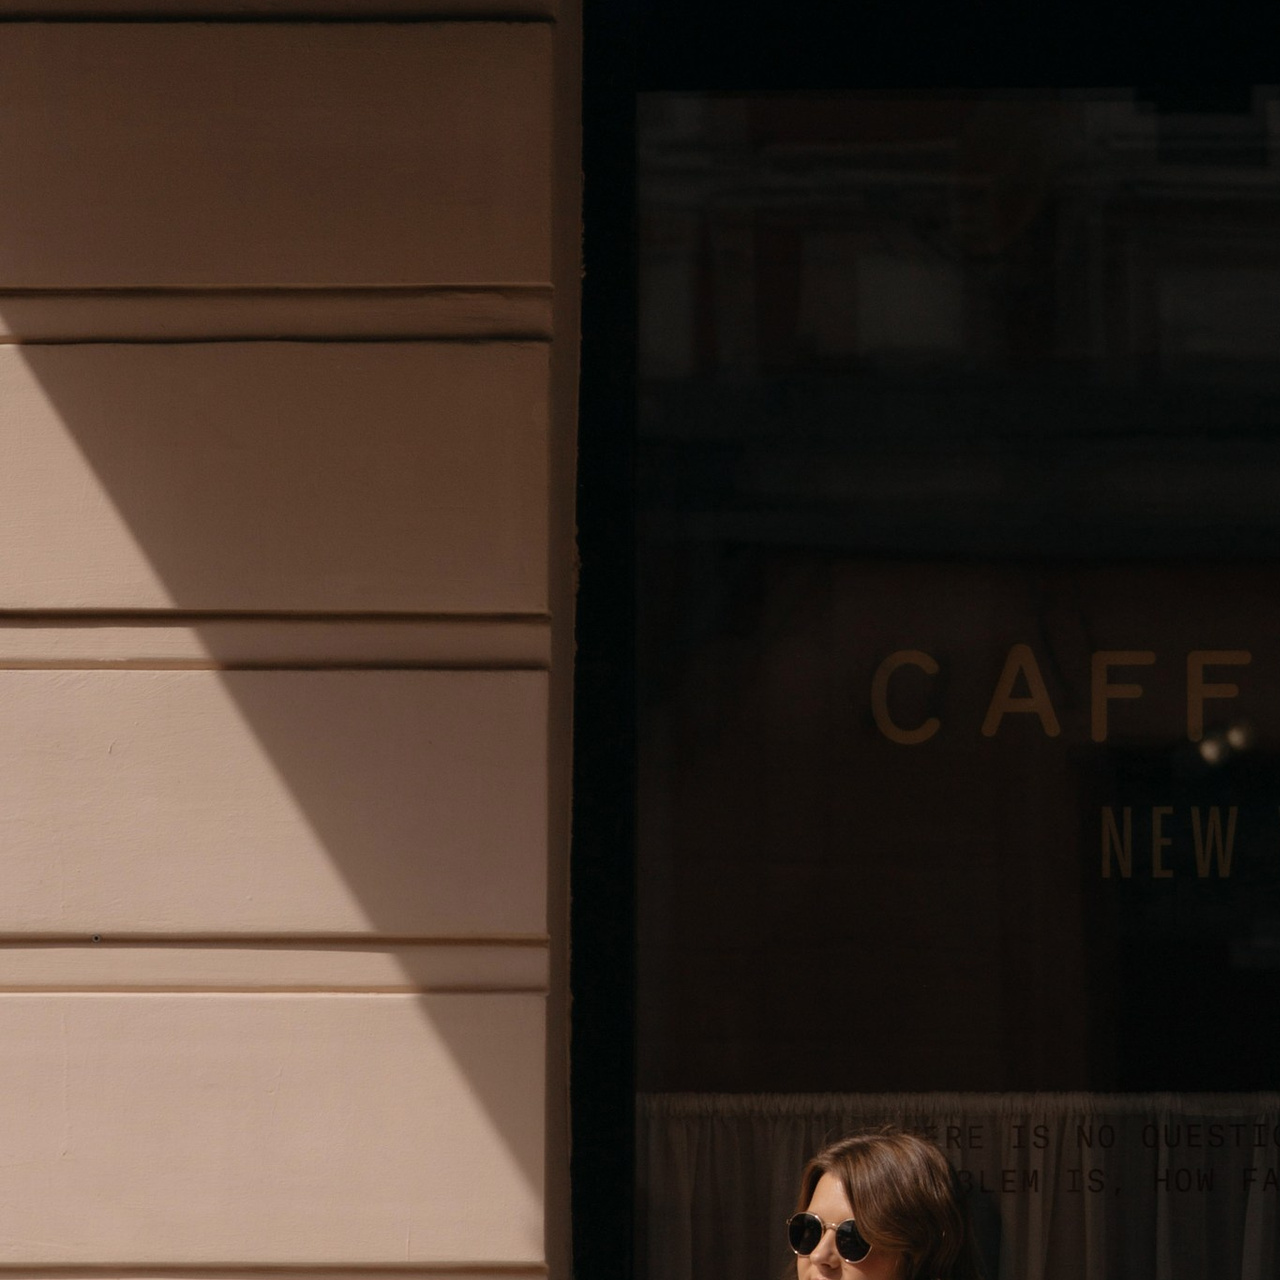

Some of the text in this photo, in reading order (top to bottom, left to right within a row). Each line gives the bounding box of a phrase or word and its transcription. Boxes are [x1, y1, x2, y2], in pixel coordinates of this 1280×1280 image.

[1101, 805, 1239, 878] NEW
[1012, 1124, 1050, 1150] IS
[1075, 1124, 1117, 1150] NO
[1066, 1168, 1124, 1197] IS,
[1153, 1166, 1214, 1193] HOW
